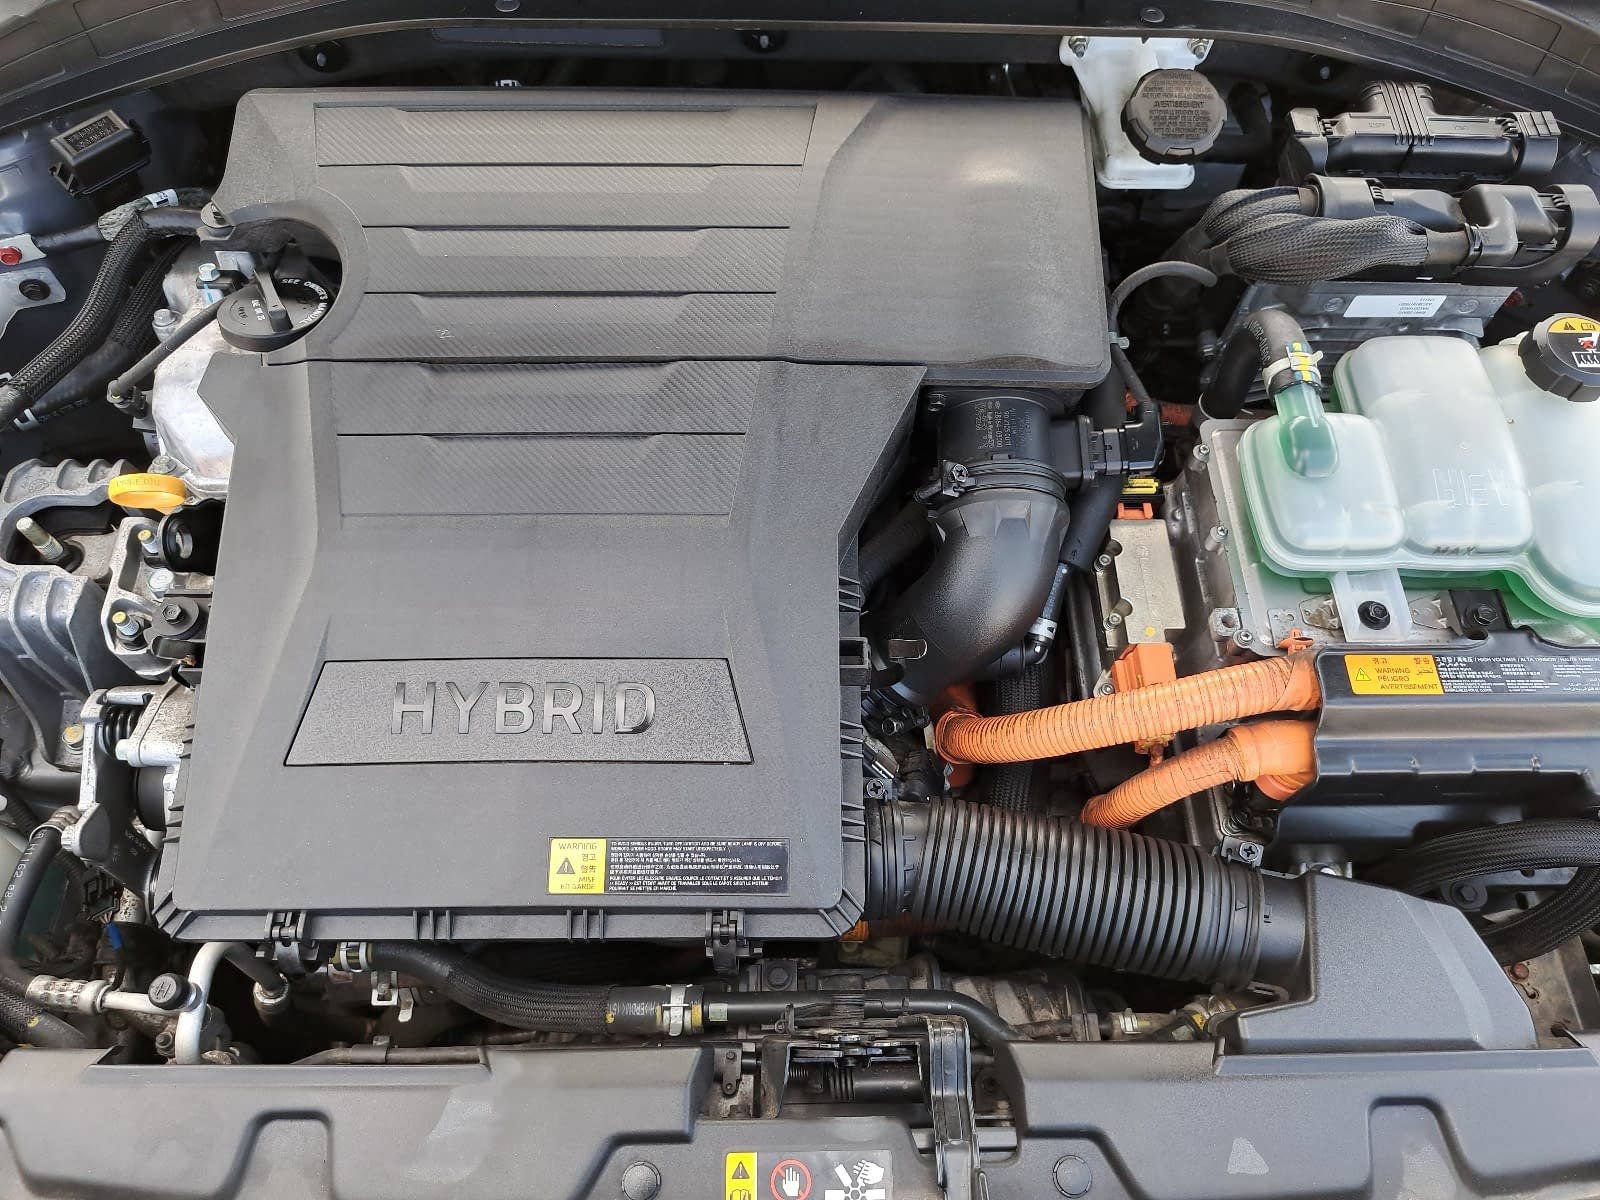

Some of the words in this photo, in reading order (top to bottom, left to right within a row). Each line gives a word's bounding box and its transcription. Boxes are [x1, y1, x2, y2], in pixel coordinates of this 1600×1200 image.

[1432, 545, 1477, 556] MAX
[391, 681, 656, 735] HYBRID
[558, 842, 598, 850] WARNING
